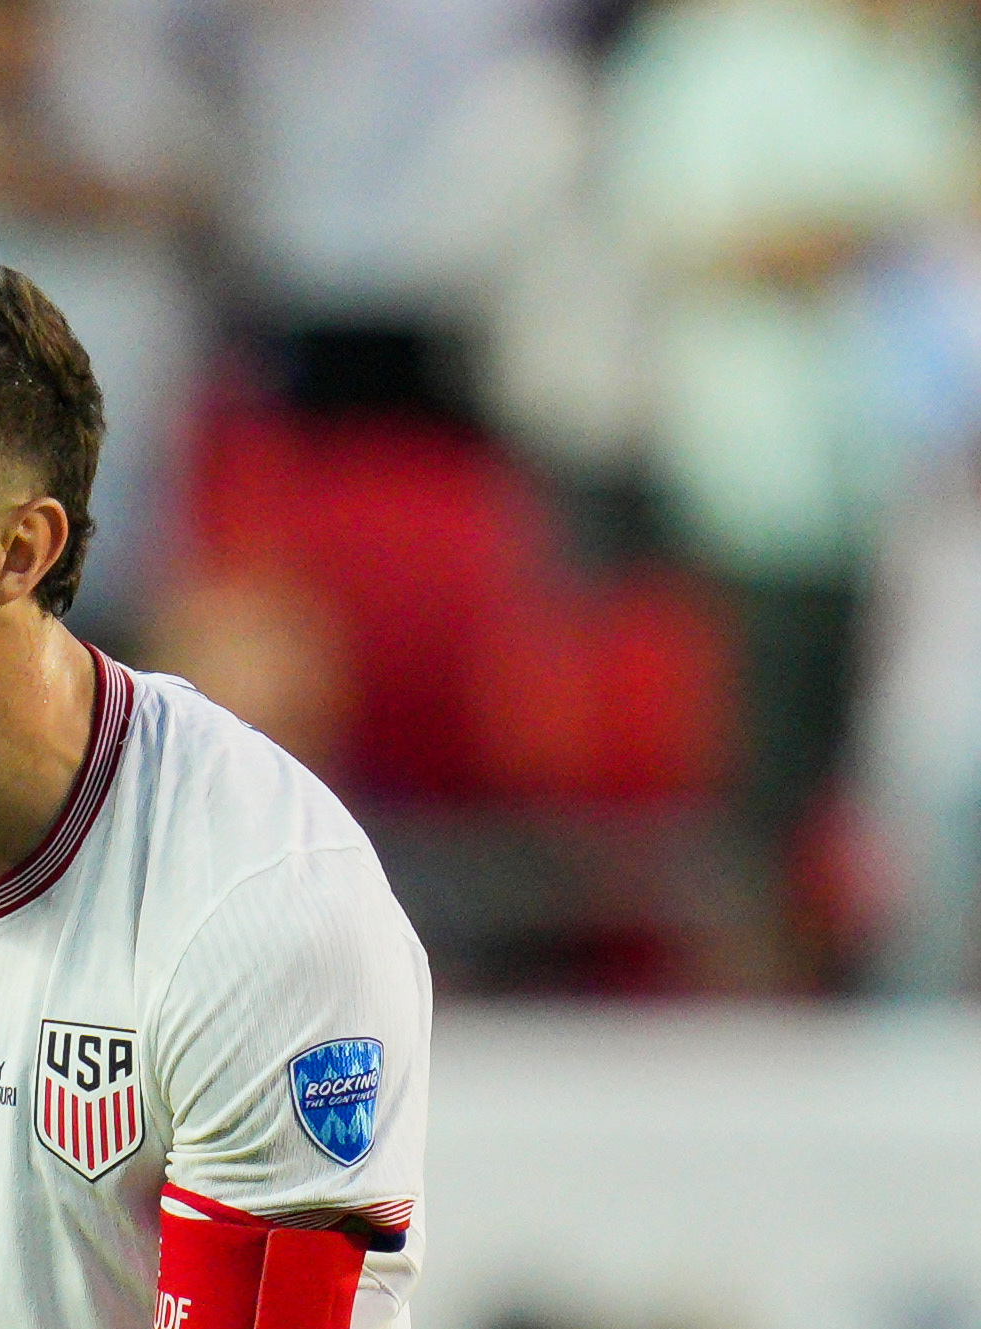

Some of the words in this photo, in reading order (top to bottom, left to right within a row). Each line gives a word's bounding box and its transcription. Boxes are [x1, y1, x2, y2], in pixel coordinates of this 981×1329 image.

[47, 1031, 132, 1092] USA
[306, 1072, 378, 1098] ROCKING
[305, 1100, 325, 1109] THE
